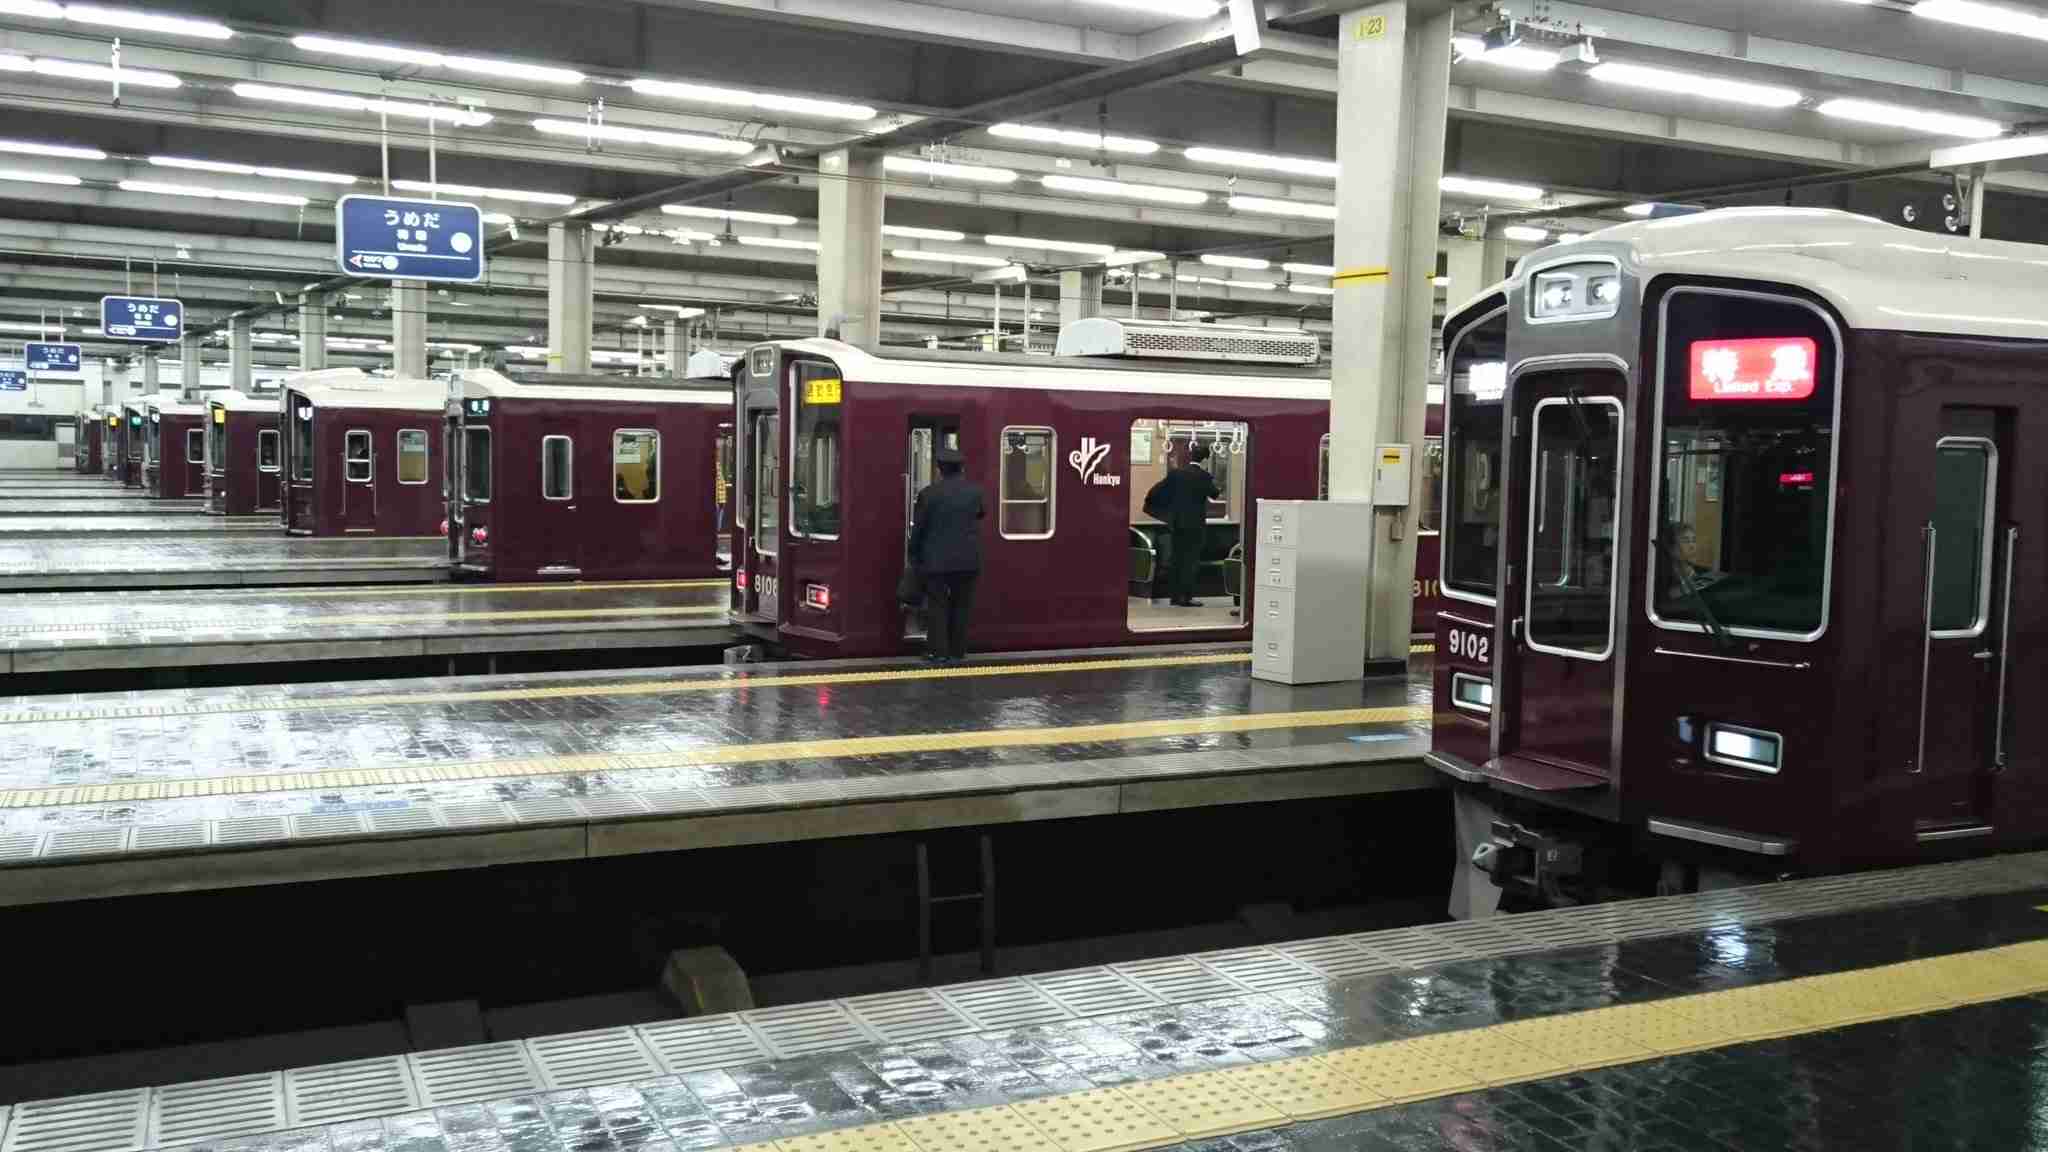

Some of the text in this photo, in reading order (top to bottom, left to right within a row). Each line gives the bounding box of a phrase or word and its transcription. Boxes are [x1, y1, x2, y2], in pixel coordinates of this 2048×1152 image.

[383, 209, 440, 229] うめだ
[1449, 629, 1489, 663] 9102
